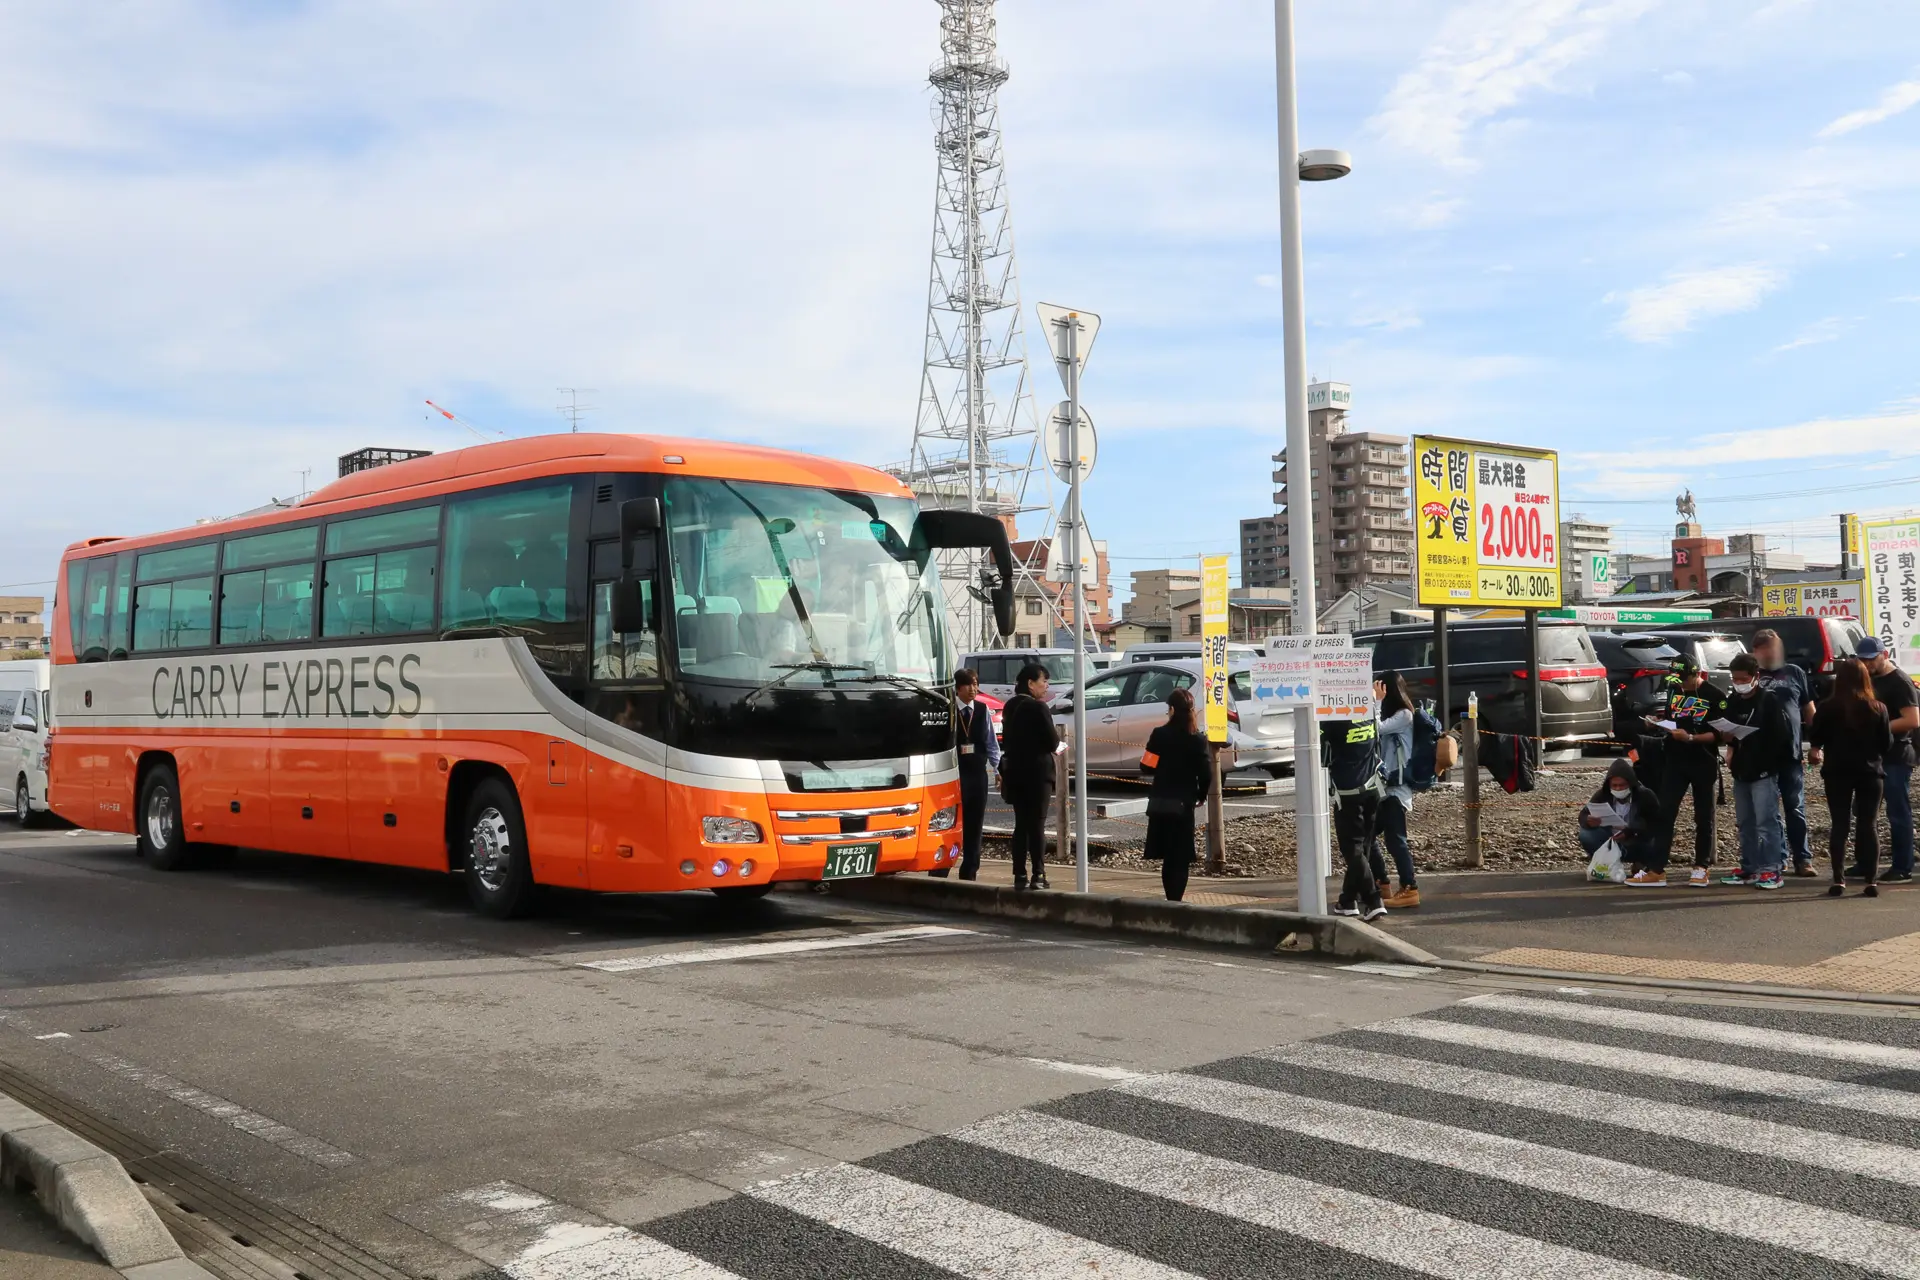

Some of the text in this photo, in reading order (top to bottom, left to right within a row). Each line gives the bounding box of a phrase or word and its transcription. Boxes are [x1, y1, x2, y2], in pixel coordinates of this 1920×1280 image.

[1479, 459, 1526, 488] 最大料金
[1481, 503, 1554, 563] 2,000円
[1676, 551, 1688, 565] R
[1481, 579, 1503, 591] オール
[1766, 588, 1798, 606] 時間
[1804, 588, 1839, 600] 最大料金
[1590, 612, 1616, 621] TOYOTA
[1619, 613, 1656, 621] トヨタレンタカー
[1273, 638, 1345, 648] MOTEGI GP EXPRESS
[152, 653, 422, 719] CARRY EXPRESS
[1320, 693, 1369, 705] This line
[920, 712, 949, 720] HINO
